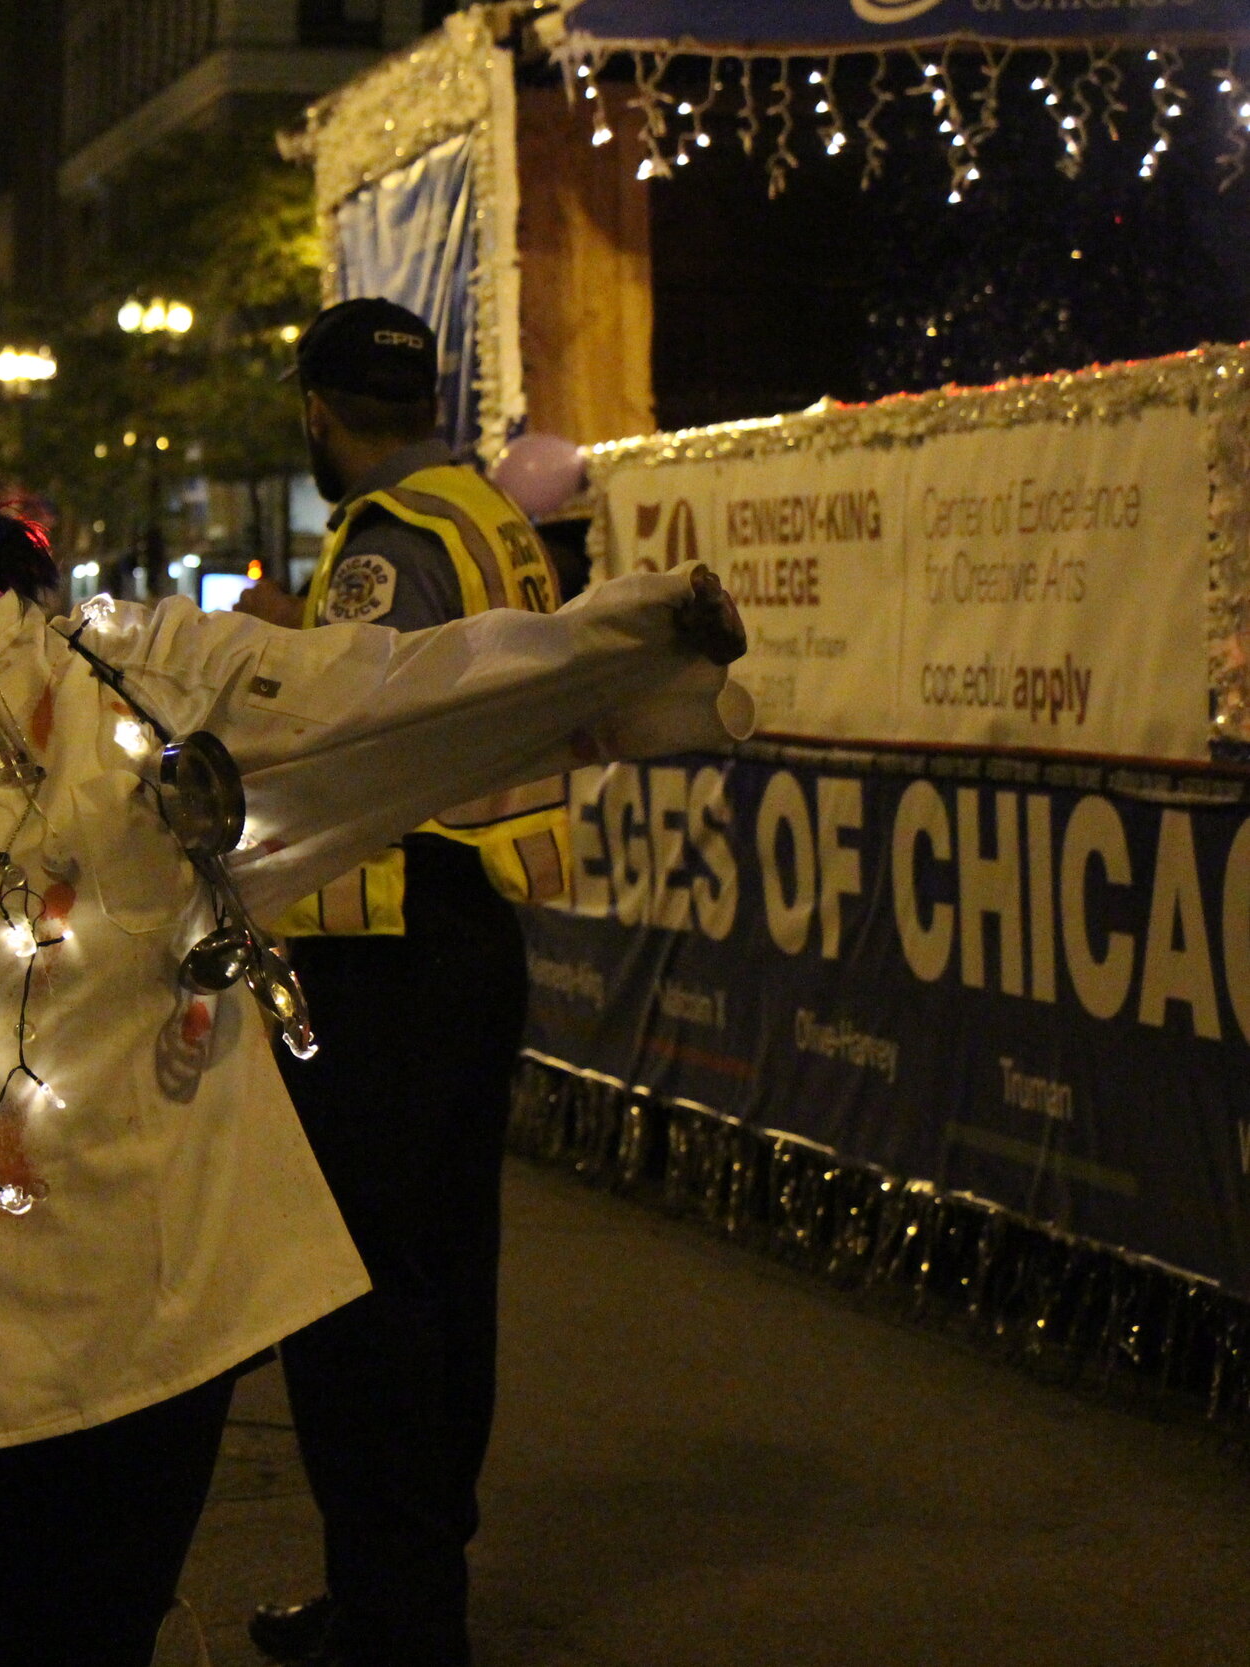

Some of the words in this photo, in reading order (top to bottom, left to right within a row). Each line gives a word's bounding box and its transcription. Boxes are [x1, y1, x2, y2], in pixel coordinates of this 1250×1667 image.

[374, 330, 424, 350] CPD
[726, 487, 882, 548] KENNEDY-KING
[923, 486, 989, 541] Center
[991, 479, 1015, 537] of
[1017, 477, 1141, 534] Excellence
[728, 556, 821, 608] COLLEGE
[952, 550, 1040, 605] Creative
[1043, 549, 1088, 604] Arts
[568, 762, 740, 942] EGES
[755, 768, 864, 961] OF
